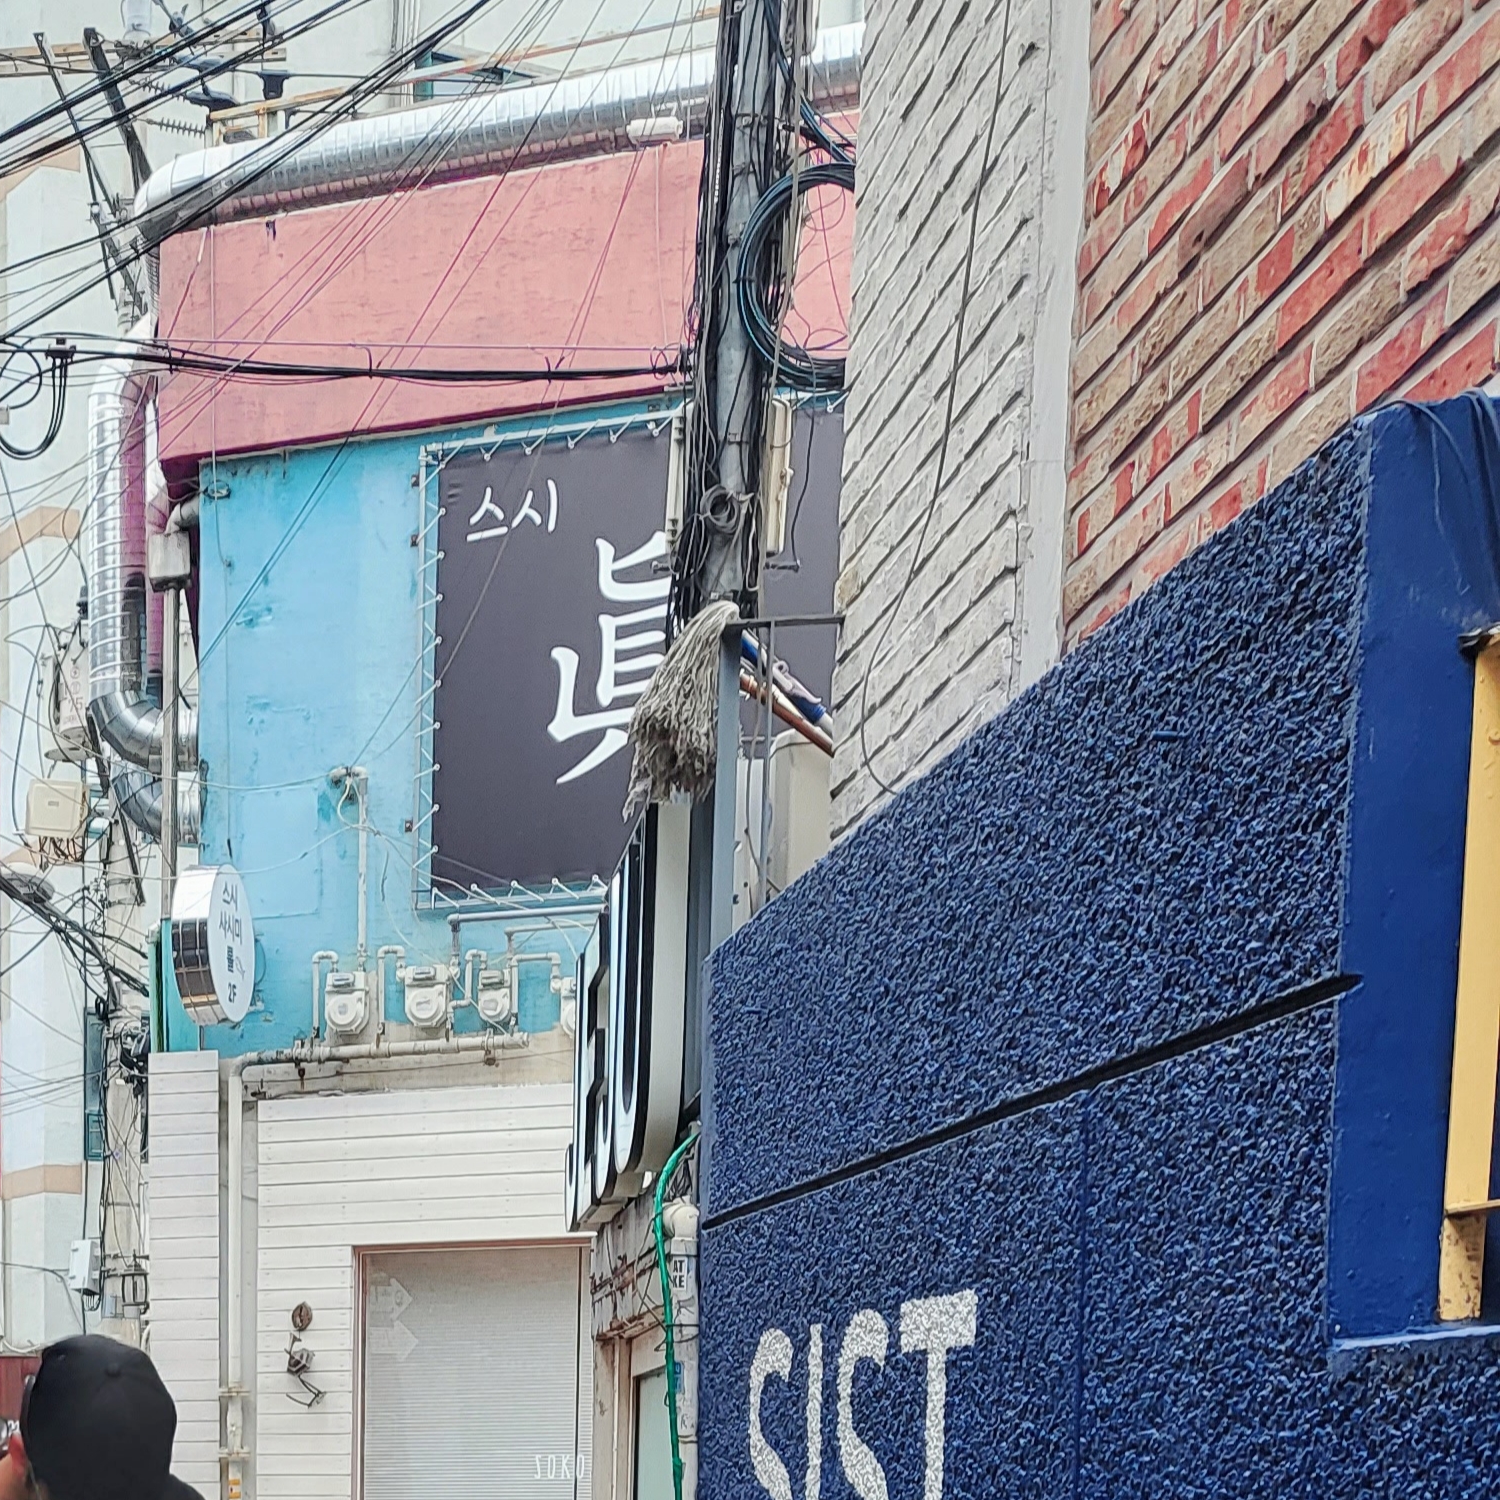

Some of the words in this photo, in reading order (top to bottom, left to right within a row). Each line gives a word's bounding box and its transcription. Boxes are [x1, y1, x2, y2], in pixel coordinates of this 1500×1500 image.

[466, 478, 558, 542] 스시
[222, 880, 238, 912] 스시
[219, 910, 243, 945] 사시미
[228, 982, 237, 1003] 2F
[533, 1454, 585, 1480] SOKO
